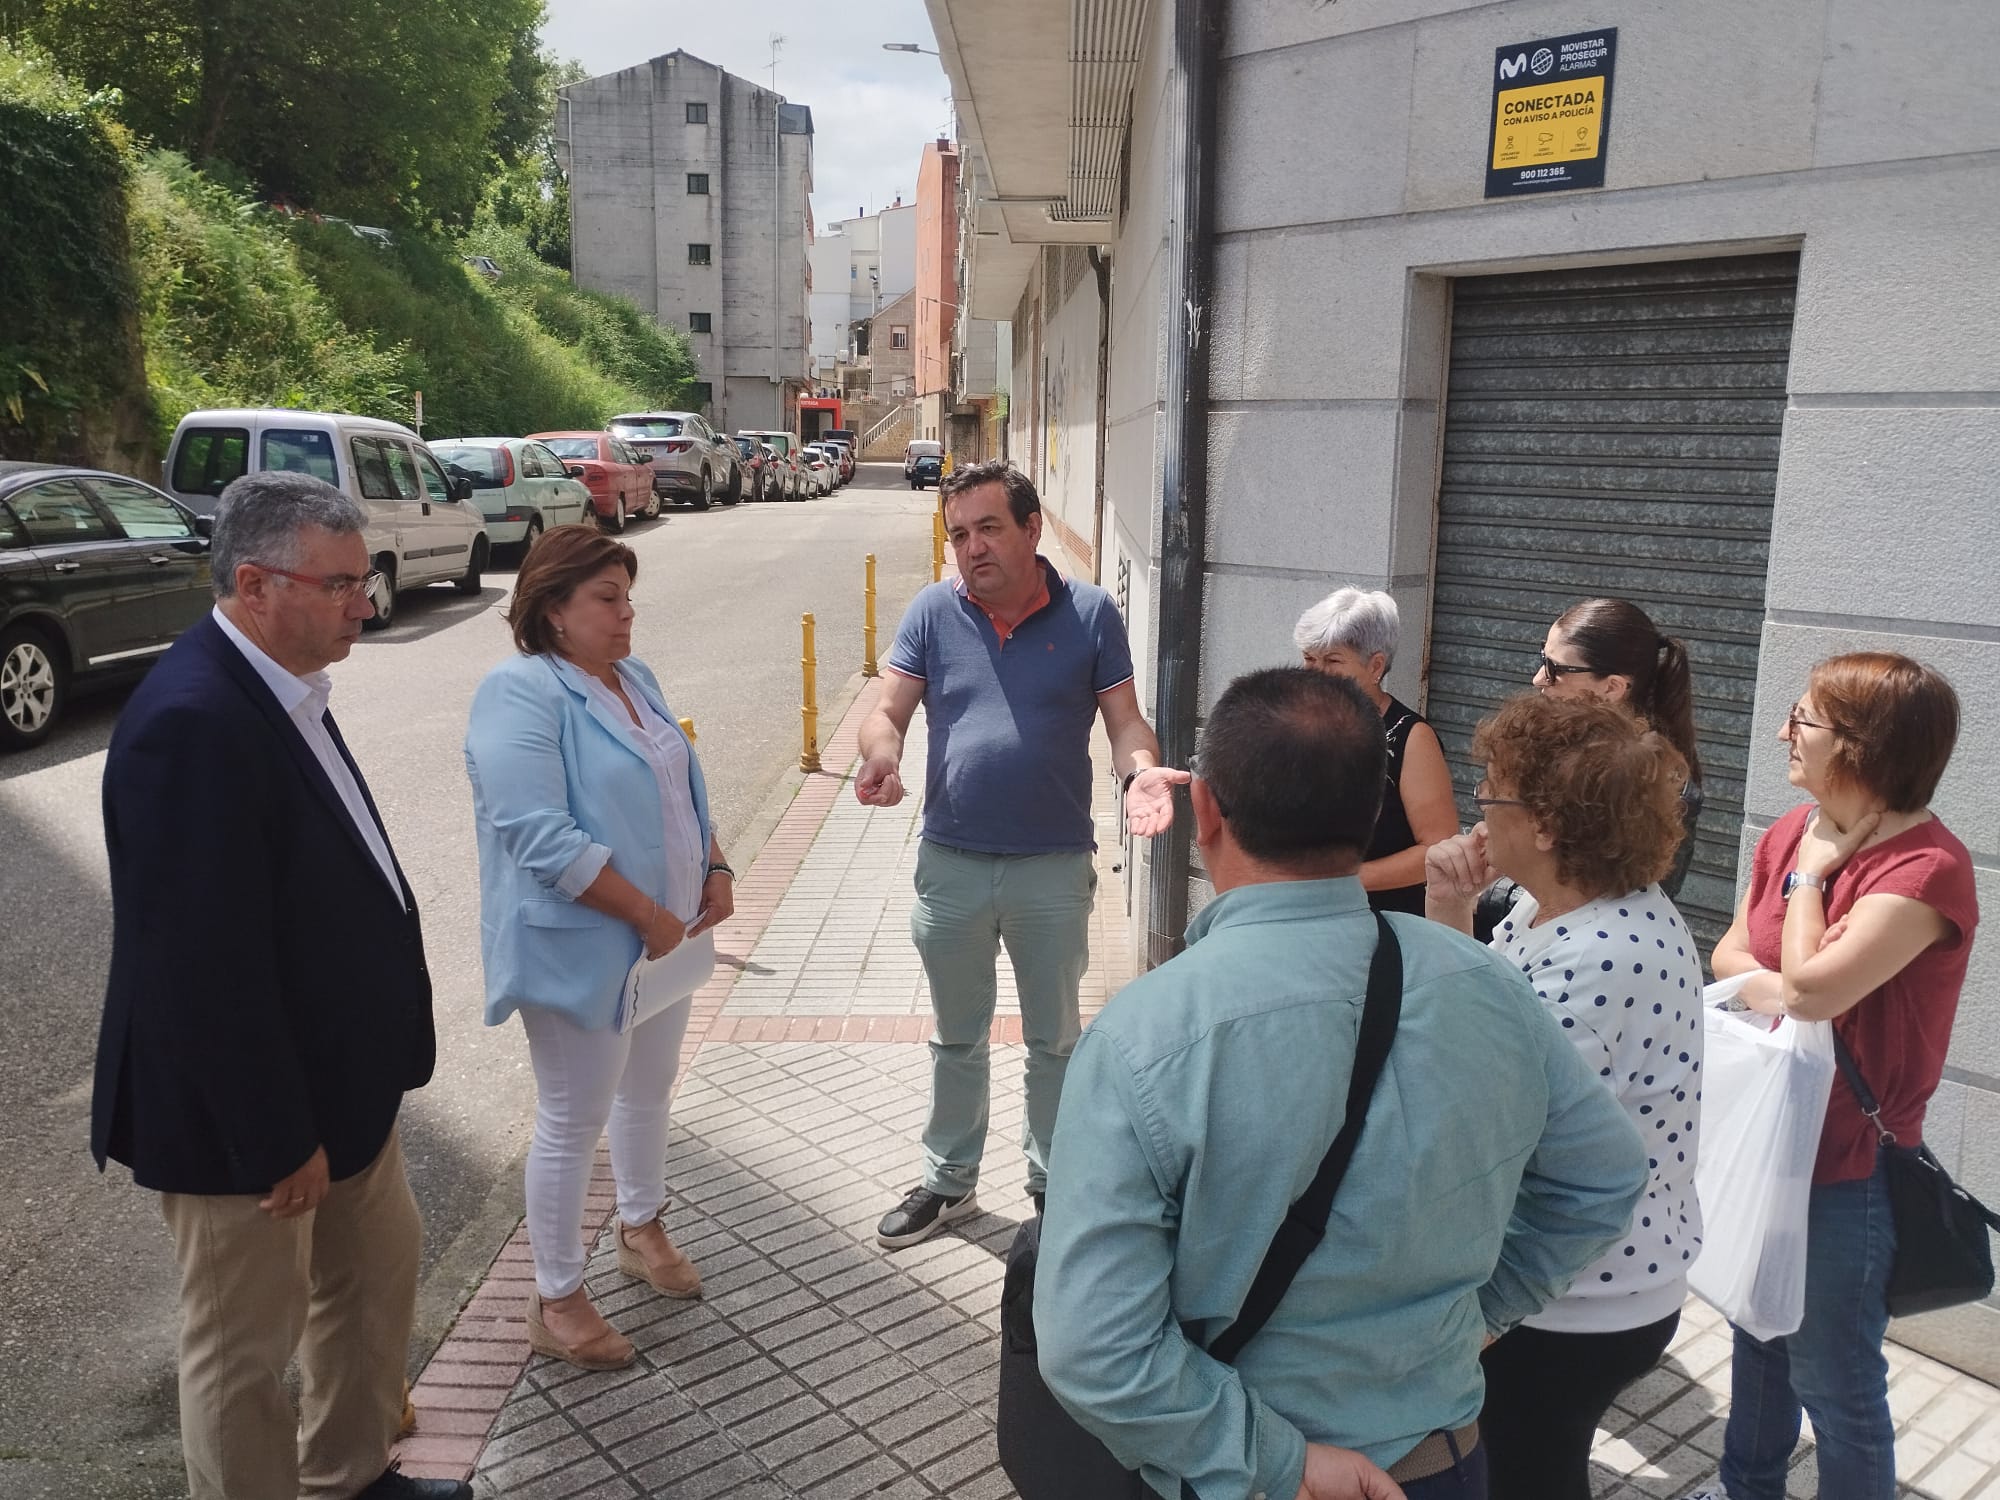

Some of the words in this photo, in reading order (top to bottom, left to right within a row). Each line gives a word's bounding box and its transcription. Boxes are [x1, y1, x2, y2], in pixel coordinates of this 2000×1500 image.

[1561, 38, 1604, 52] MOVISTAR
[1560, 48, 1607, 62] PROSEGUR
[1560, 60, 1597, 72] ALARMAS
[1504, 91, 1595, 114] CONECTADA
[1504, 117, 1521, 126] CON
[1523, 113, 1550, 124] AVISO
[1552, 111, 1557, 119] A
[1559, 105, 1594, 118] POLICÍA
[1520, 170, 1536, 180] 900
[1537, 168, 1548, 177] 112
[1549, 167, 1565, 177] 365
